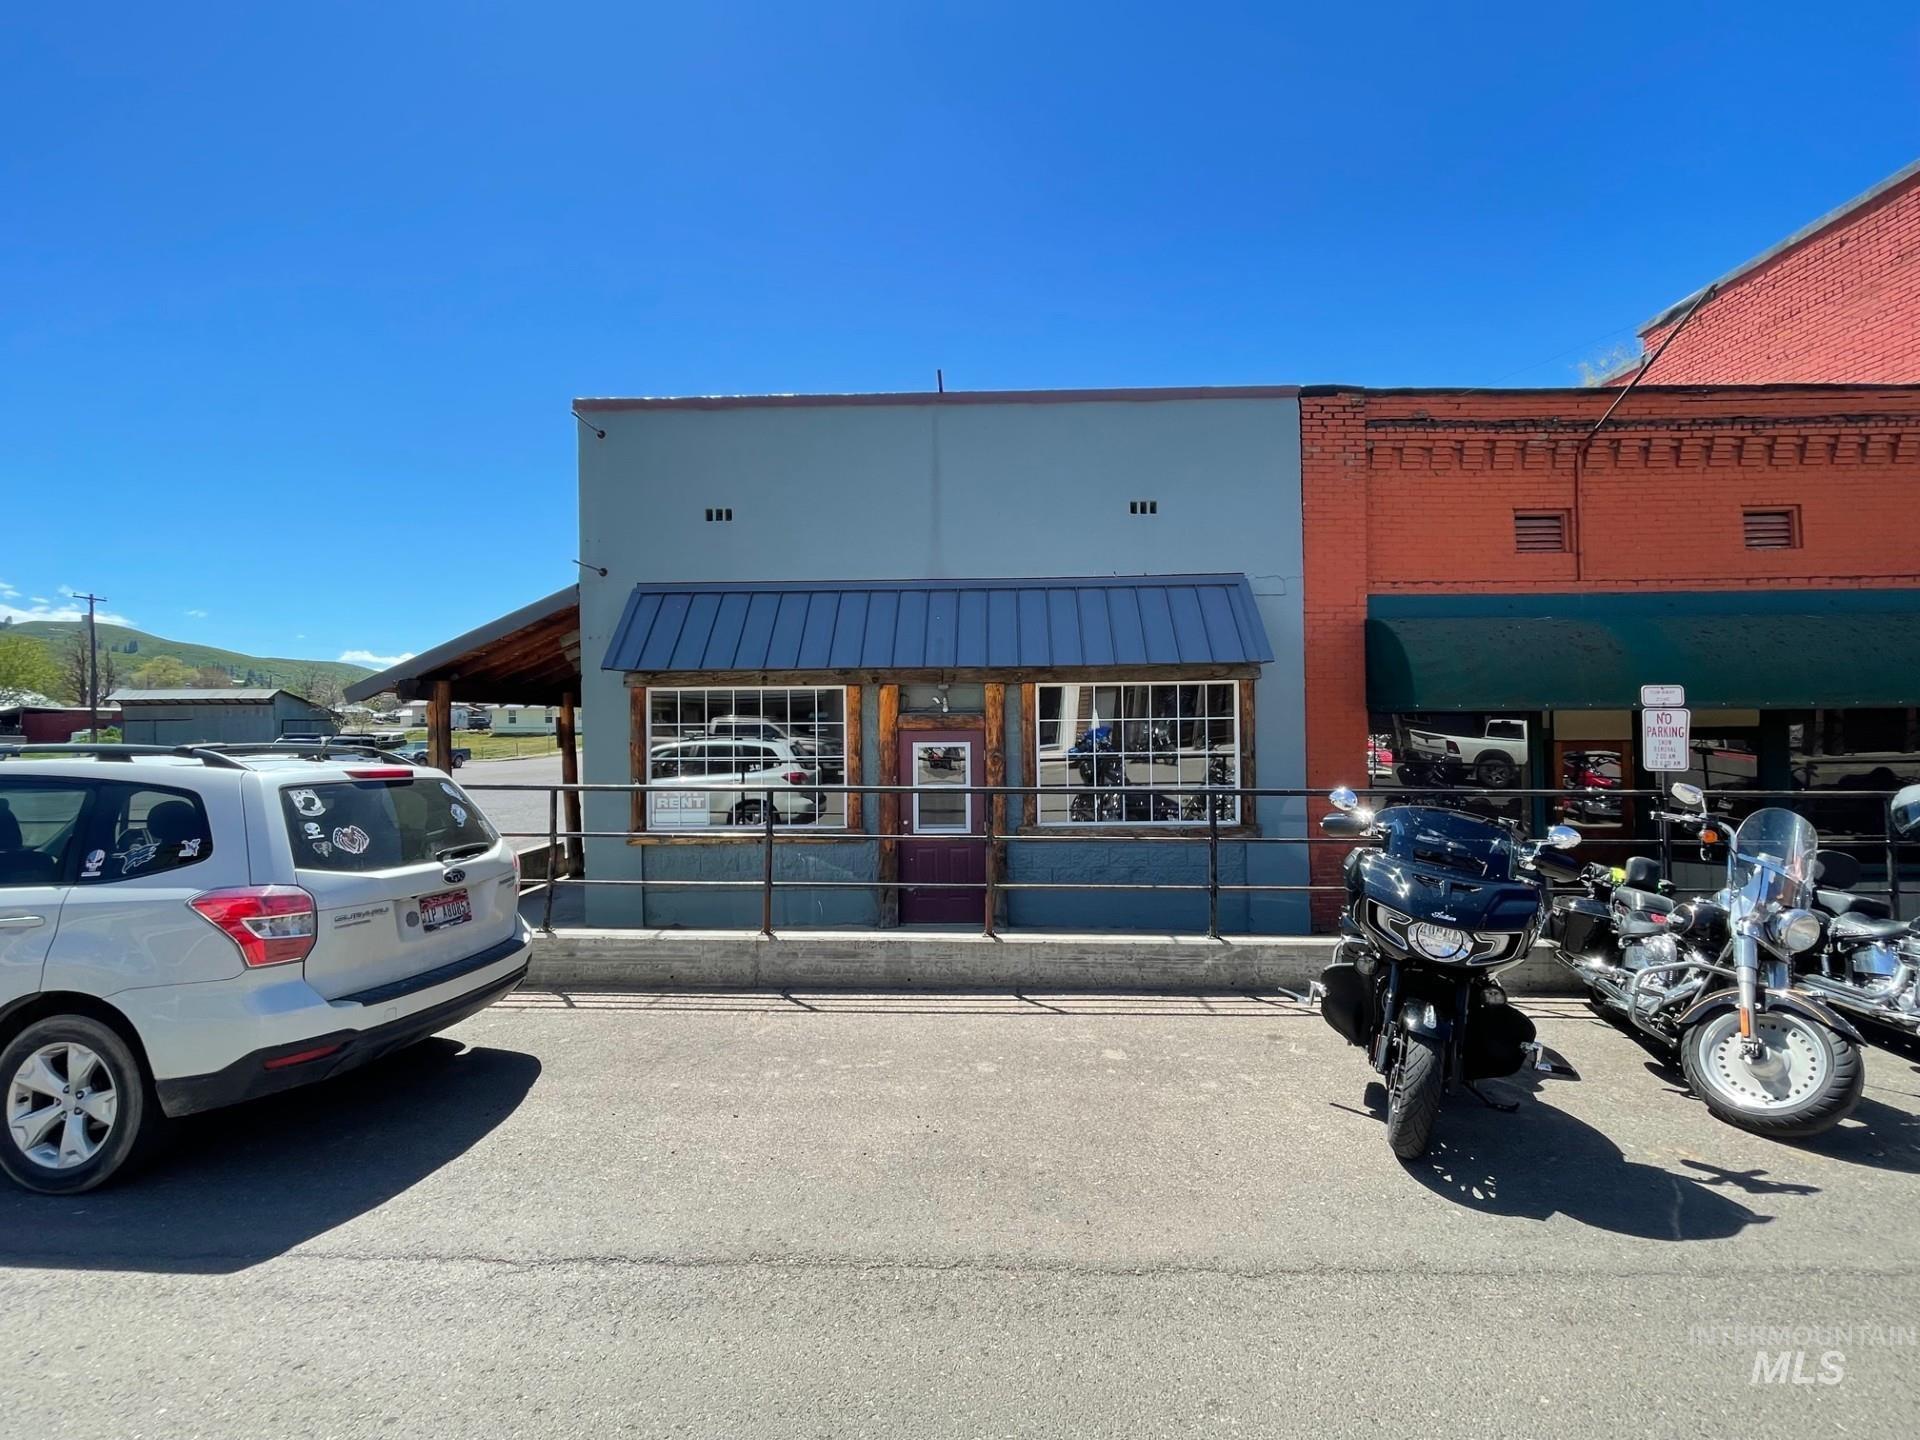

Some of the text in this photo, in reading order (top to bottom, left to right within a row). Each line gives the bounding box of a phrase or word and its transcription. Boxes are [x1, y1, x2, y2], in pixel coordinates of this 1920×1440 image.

[1656, 713, 1672, 725] NO
[1647, 726, 1685, 738] PARKING
[656, 797, 705, 809] RENT
